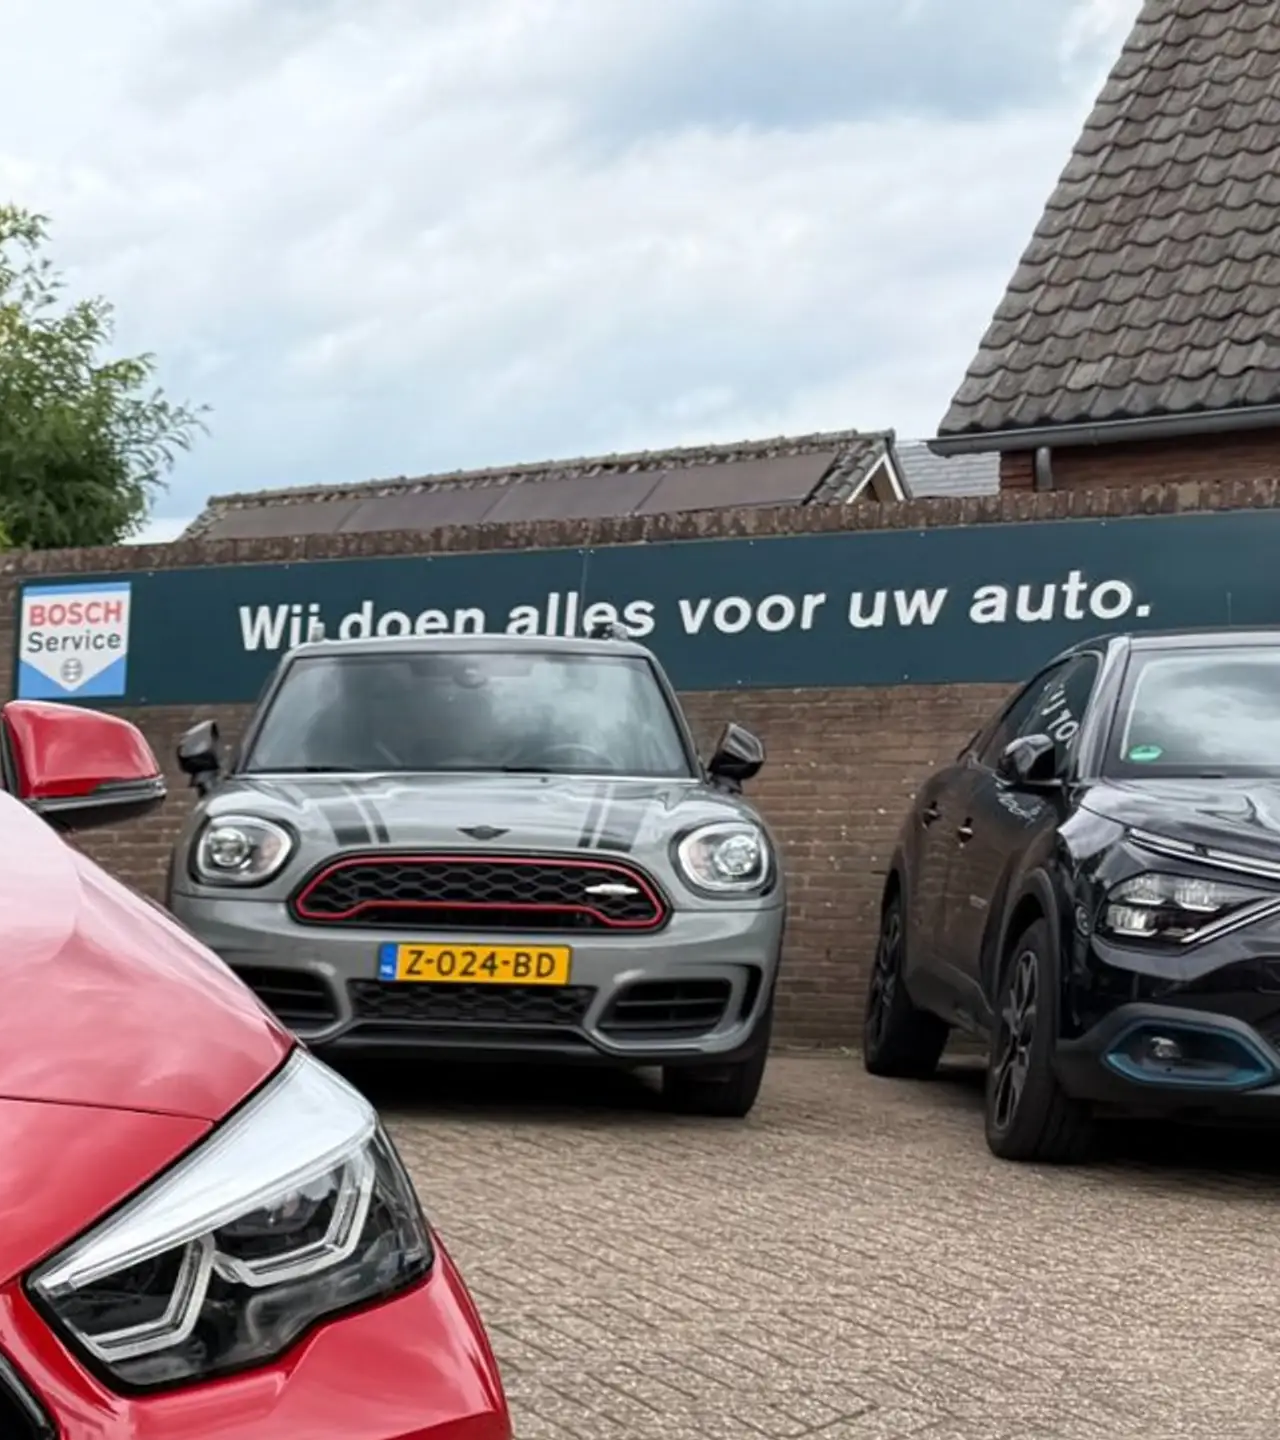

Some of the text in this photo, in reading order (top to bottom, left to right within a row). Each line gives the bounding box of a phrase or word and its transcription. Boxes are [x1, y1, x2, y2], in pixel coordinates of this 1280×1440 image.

[29, 601, 122, 626] BOSCH
[339, 600, 484, 641] doen
[506, 590, 656, 640] alles
[678, 592, 827, 635] voor
[848, 587, 949, 629] uw
[969, 568, 1153, 625] auto.
[26, 629, 122, 654] Service
[405, 949, 556, 978] Z-024-BD
